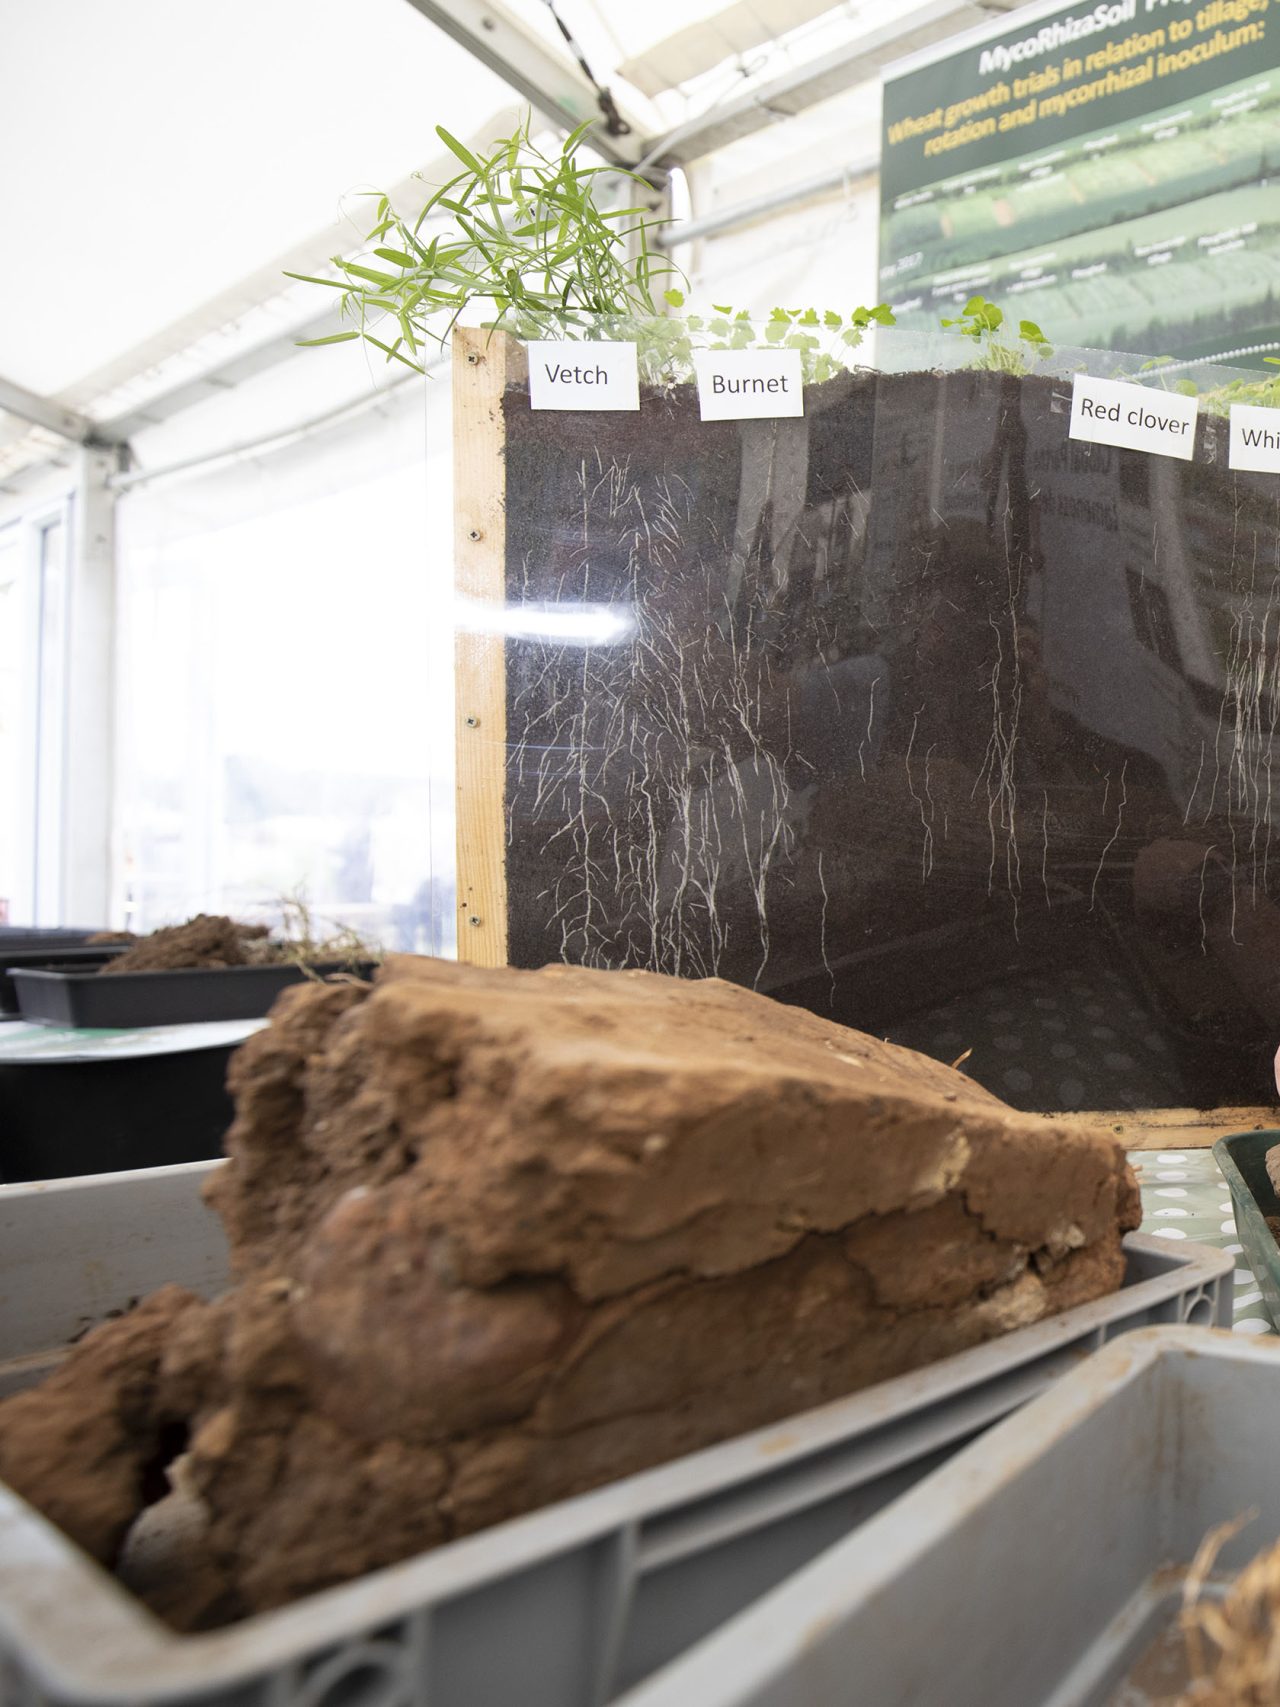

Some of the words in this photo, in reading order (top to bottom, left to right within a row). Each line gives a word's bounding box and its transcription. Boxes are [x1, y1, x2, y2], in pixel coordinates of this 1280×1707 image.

[978, 0, 1136, 75] MycoRhizaSoil
[888, 107, 944, 146] Wheat
[943, 81, 1011, 130] growth
[1012, 64, 1061, 100] trials
[1062, 56, 1083, 81] in
[1085, 28, 1166, 73] relation
[1168, 18, 1194, 43] to
[924, 117, 997, 158] rotation
[998, 98, 1038, 133] and
[1039, 56, 1154, 118] mycorrhizal
[1157, 20, 1266, 77] inoculum:
[545, 363, 609, 386] Vetch
[712, 374, 789, 394] Burnet
[1081, 397, 1121, 422] Red
[1127, 406, 1190, 436] clover
